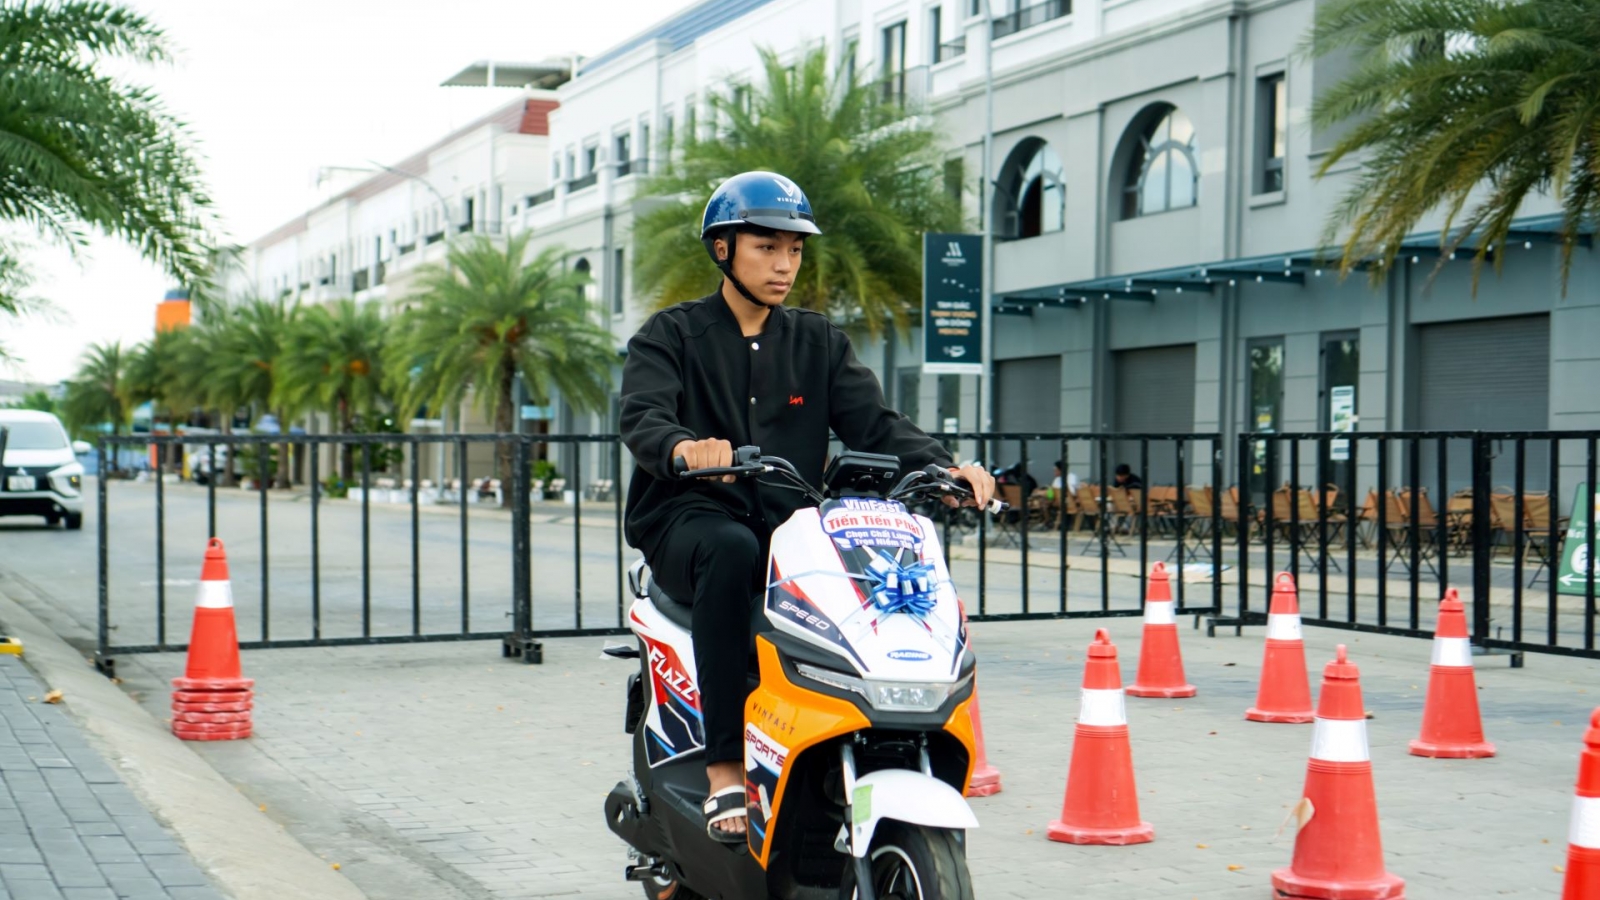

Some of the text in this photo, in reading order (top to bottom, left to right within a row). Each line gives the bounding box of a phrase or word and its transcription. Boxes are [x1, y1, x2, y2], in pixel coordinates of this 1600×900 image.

[843, 498, 900, 513] VinFast
[827, 514, 859, 530] Tiến
[861, 514, 892, 527] Tiến
[778, 600, 831, 631] SPEED
[889, 651, 929, 660] RACING
[649, 645, 696, 701] FLAZZ
[752, 702, 795, 735] VINFAST
[745, 729, 786, 767] SPORTS
